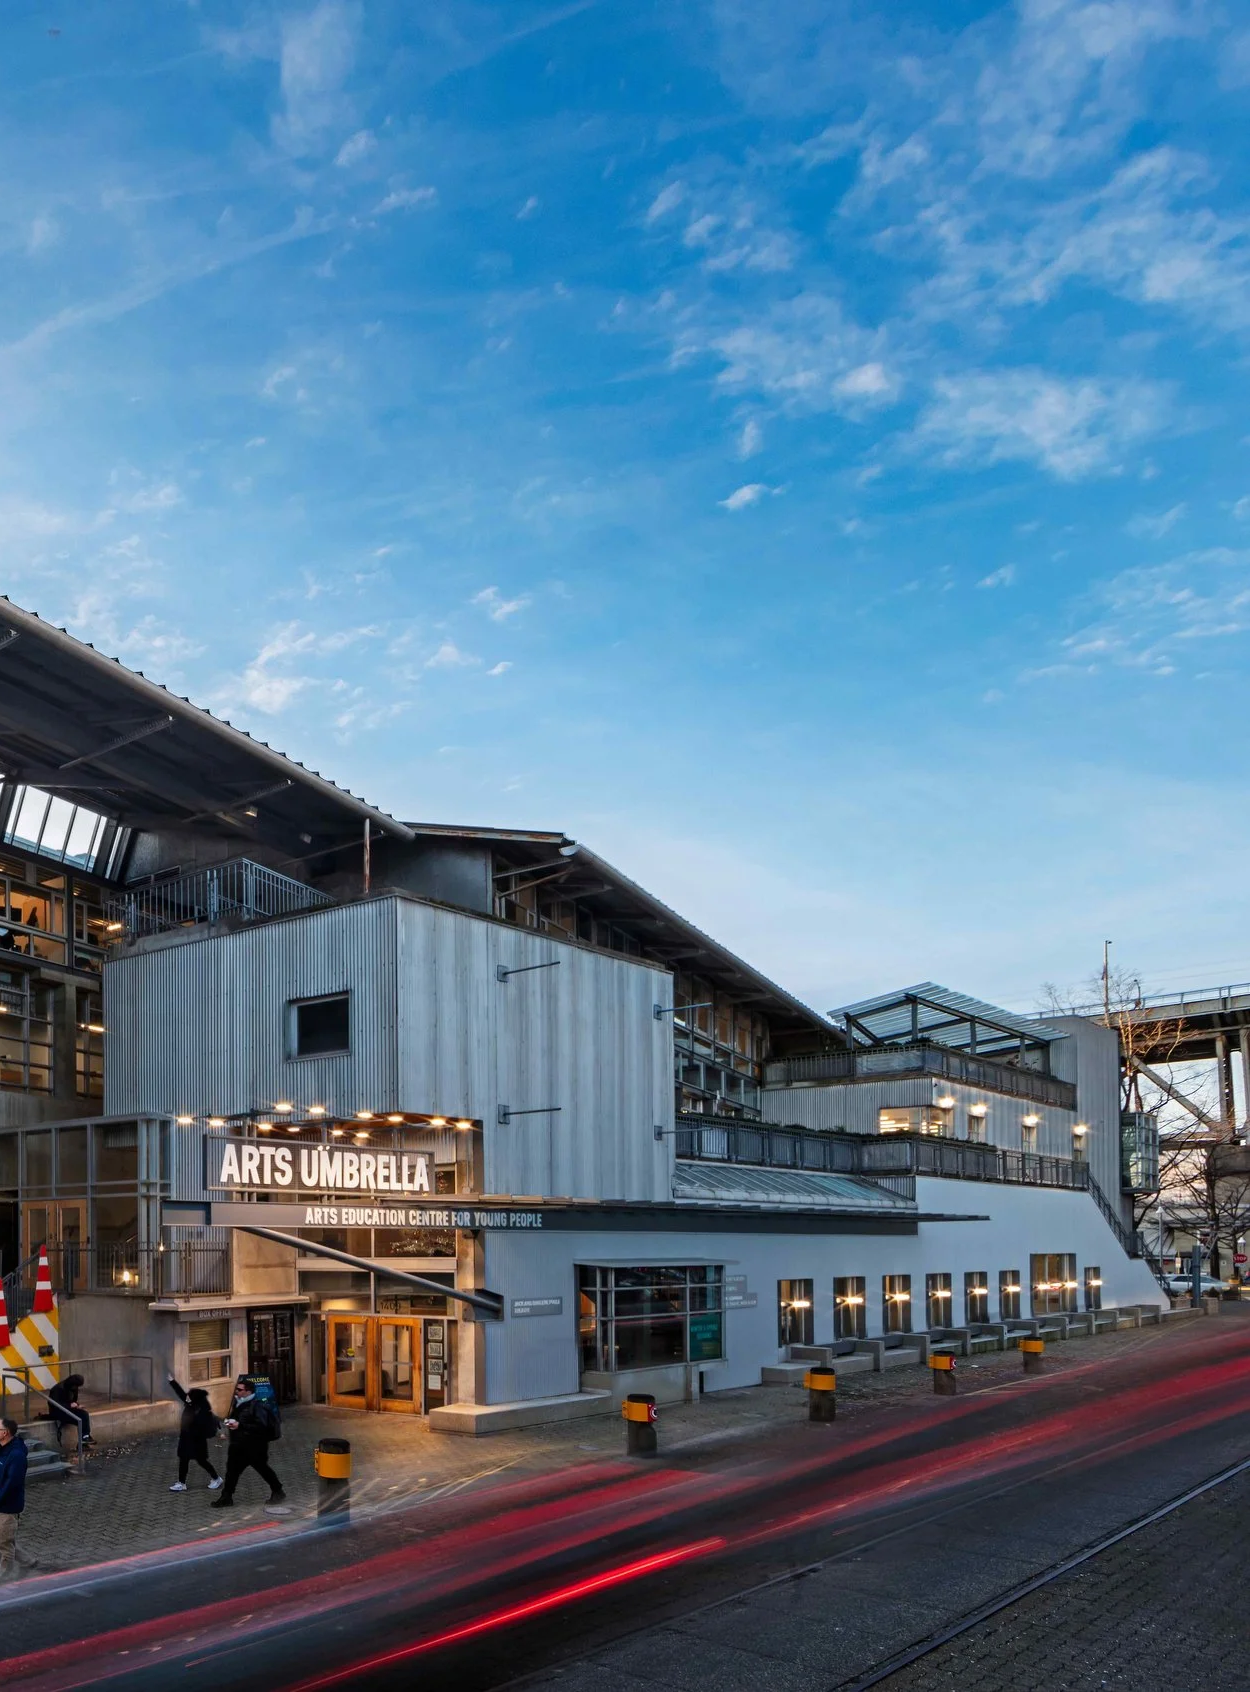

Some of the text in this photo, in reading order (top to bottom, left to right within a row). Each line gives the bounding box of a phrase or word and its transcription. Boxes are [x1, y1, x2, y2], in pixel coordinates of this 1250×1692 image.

[220, 1144, 430, 1192] ARTS UMBRELLA
[305, 1207, 543, 1228] ARTS EDUCATION CENTRE FOR YOUNG PEOPLE
[199, 1309, 232, 1318] BOX OFFICE
